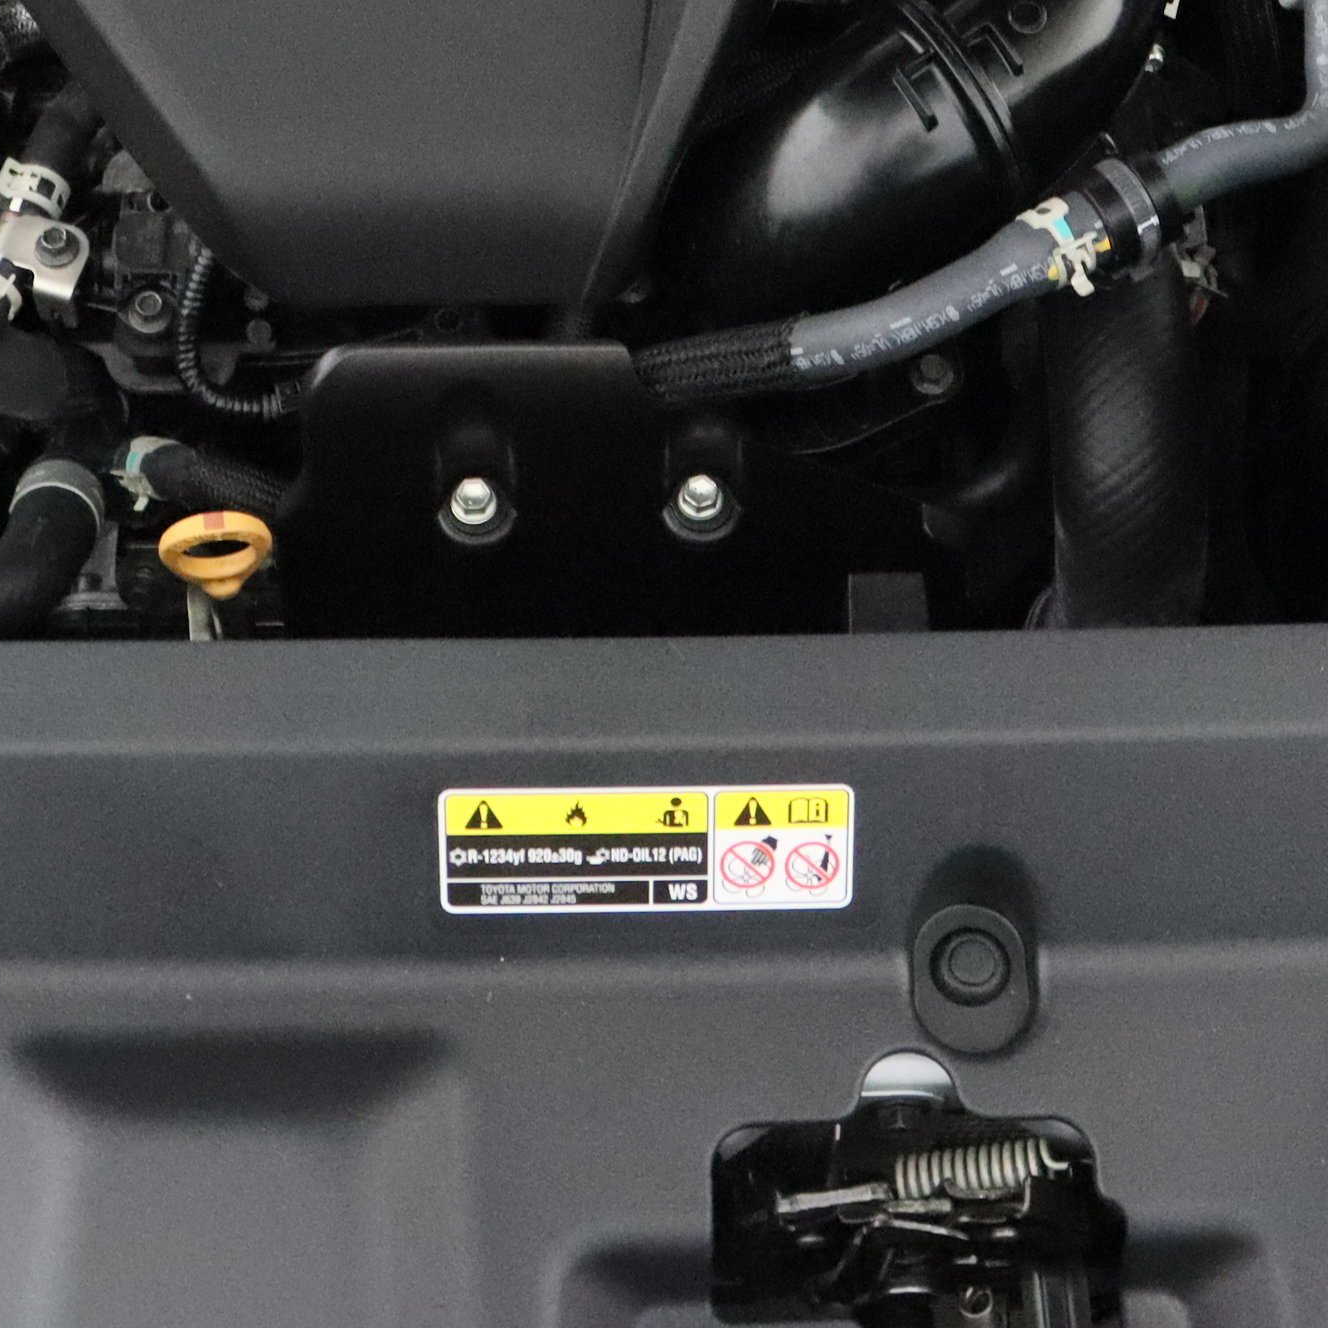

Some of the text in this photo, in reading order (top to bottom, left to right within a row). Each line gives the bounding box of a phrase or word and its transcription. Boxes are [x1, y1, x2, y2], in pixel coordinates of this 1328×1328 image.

[527, 848, 583, 865] 920±30g
[610, 847, 667, 863] ND-OIL12
[668, 847, 703, 864] (PAG)
[480, 883, 615, 894] TOYOTA MOTOR CORPORATION
[668, 883, 698, 901] WS
